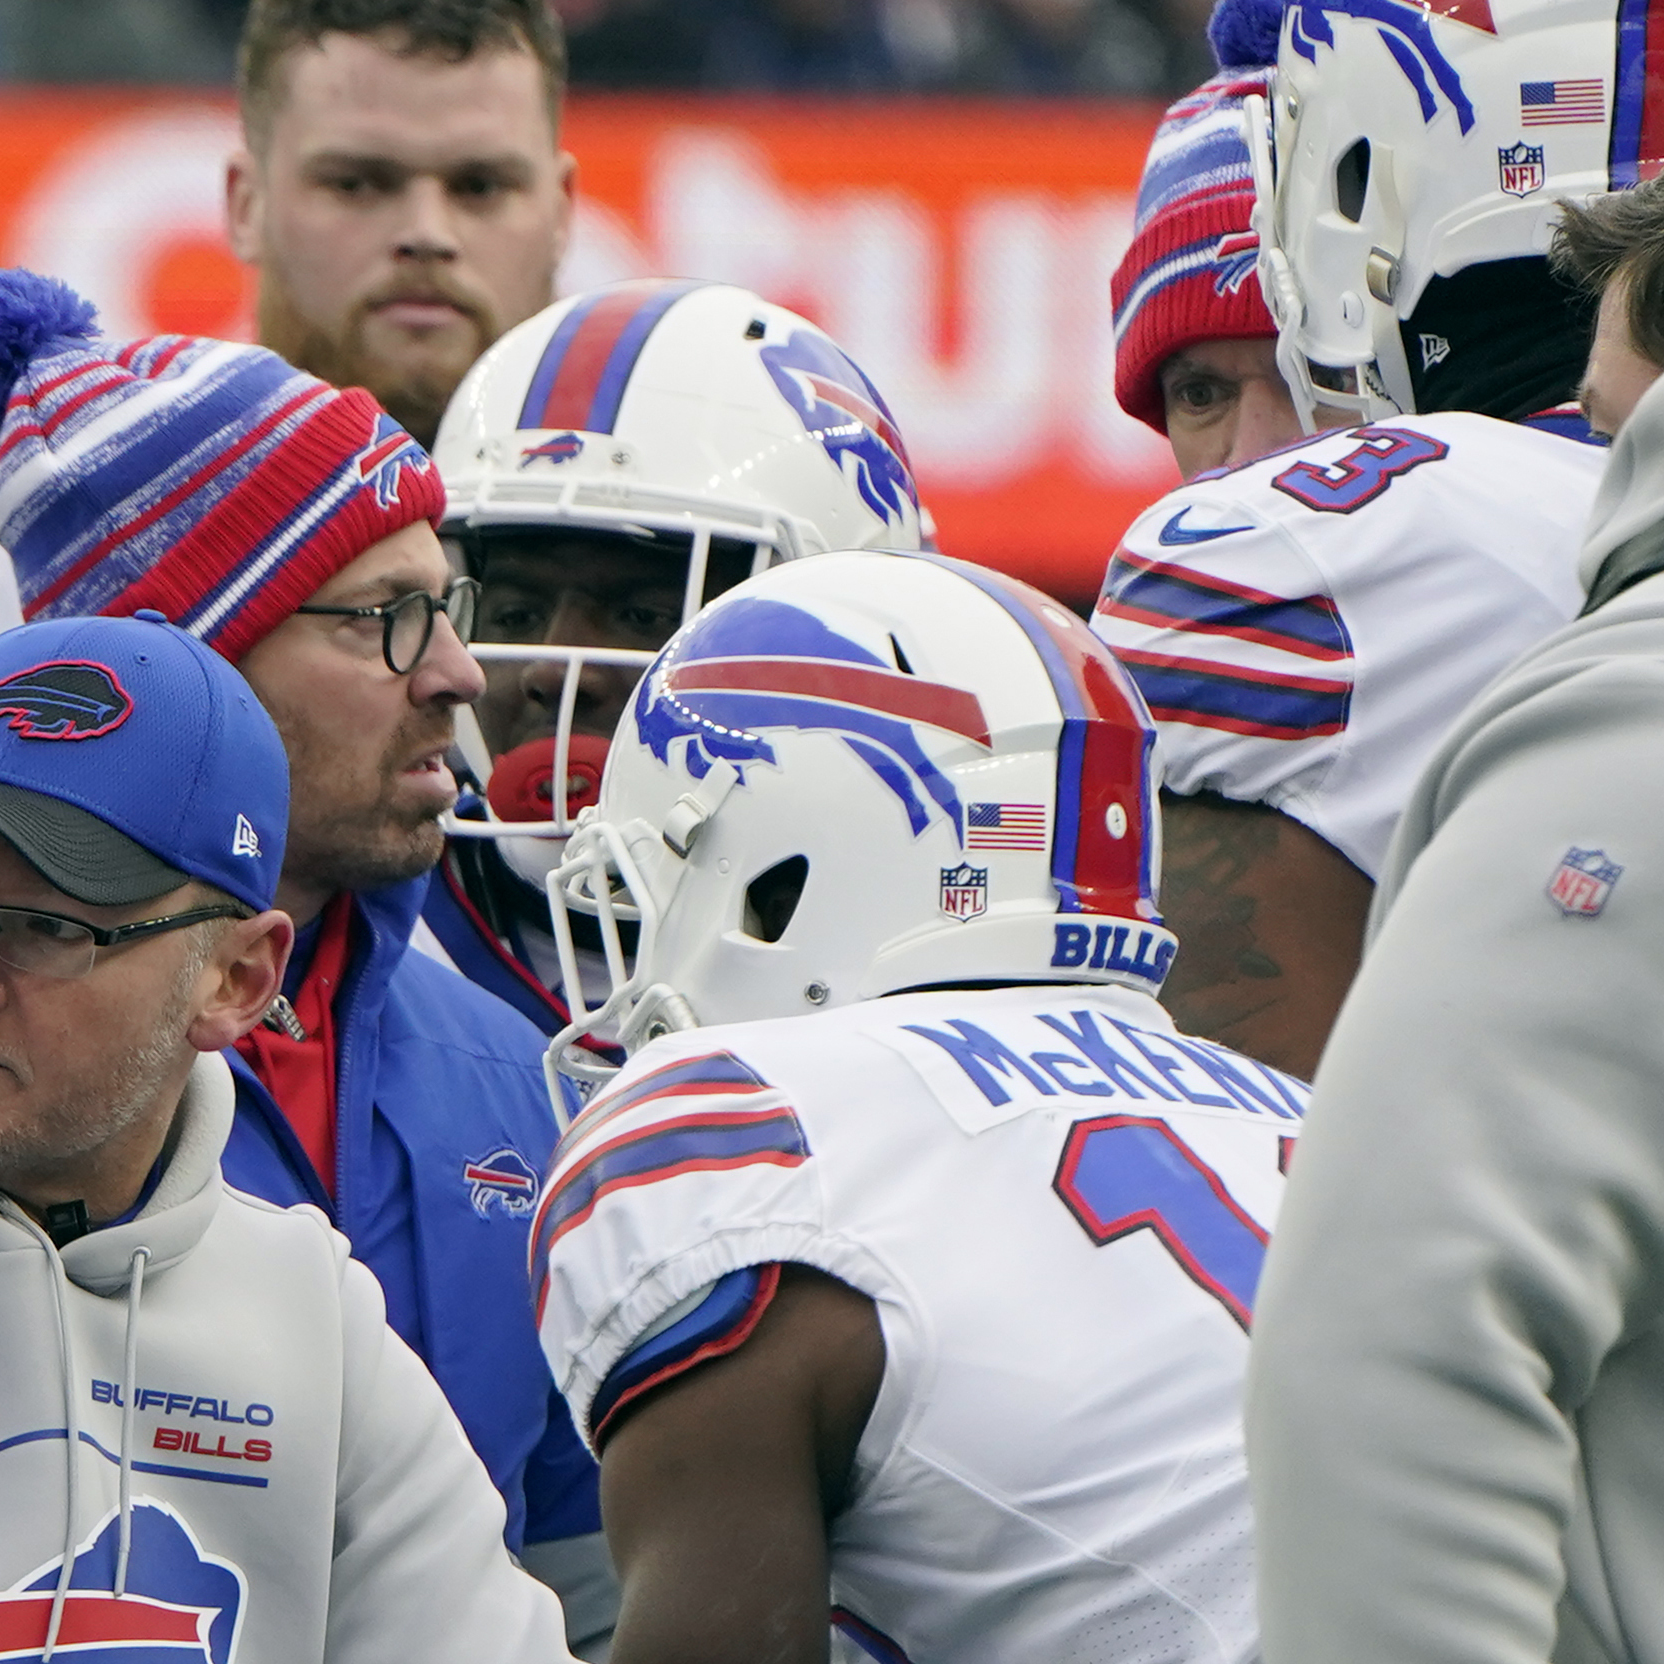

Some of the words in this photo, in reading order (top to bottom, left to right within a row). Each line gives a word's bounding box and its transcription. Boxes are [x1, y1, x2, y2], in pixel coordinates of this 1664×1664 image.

[1503, 166, 1540, 192] NFL
[944, 889, 983, 916] NFL
[1553, 868, 1601, 911] NFL
[1051, 923, 1177, 984] BILLS
[91, 1379, 274, 1427] BUFFALO
[153, 1427, 273, 1462] BILLS
